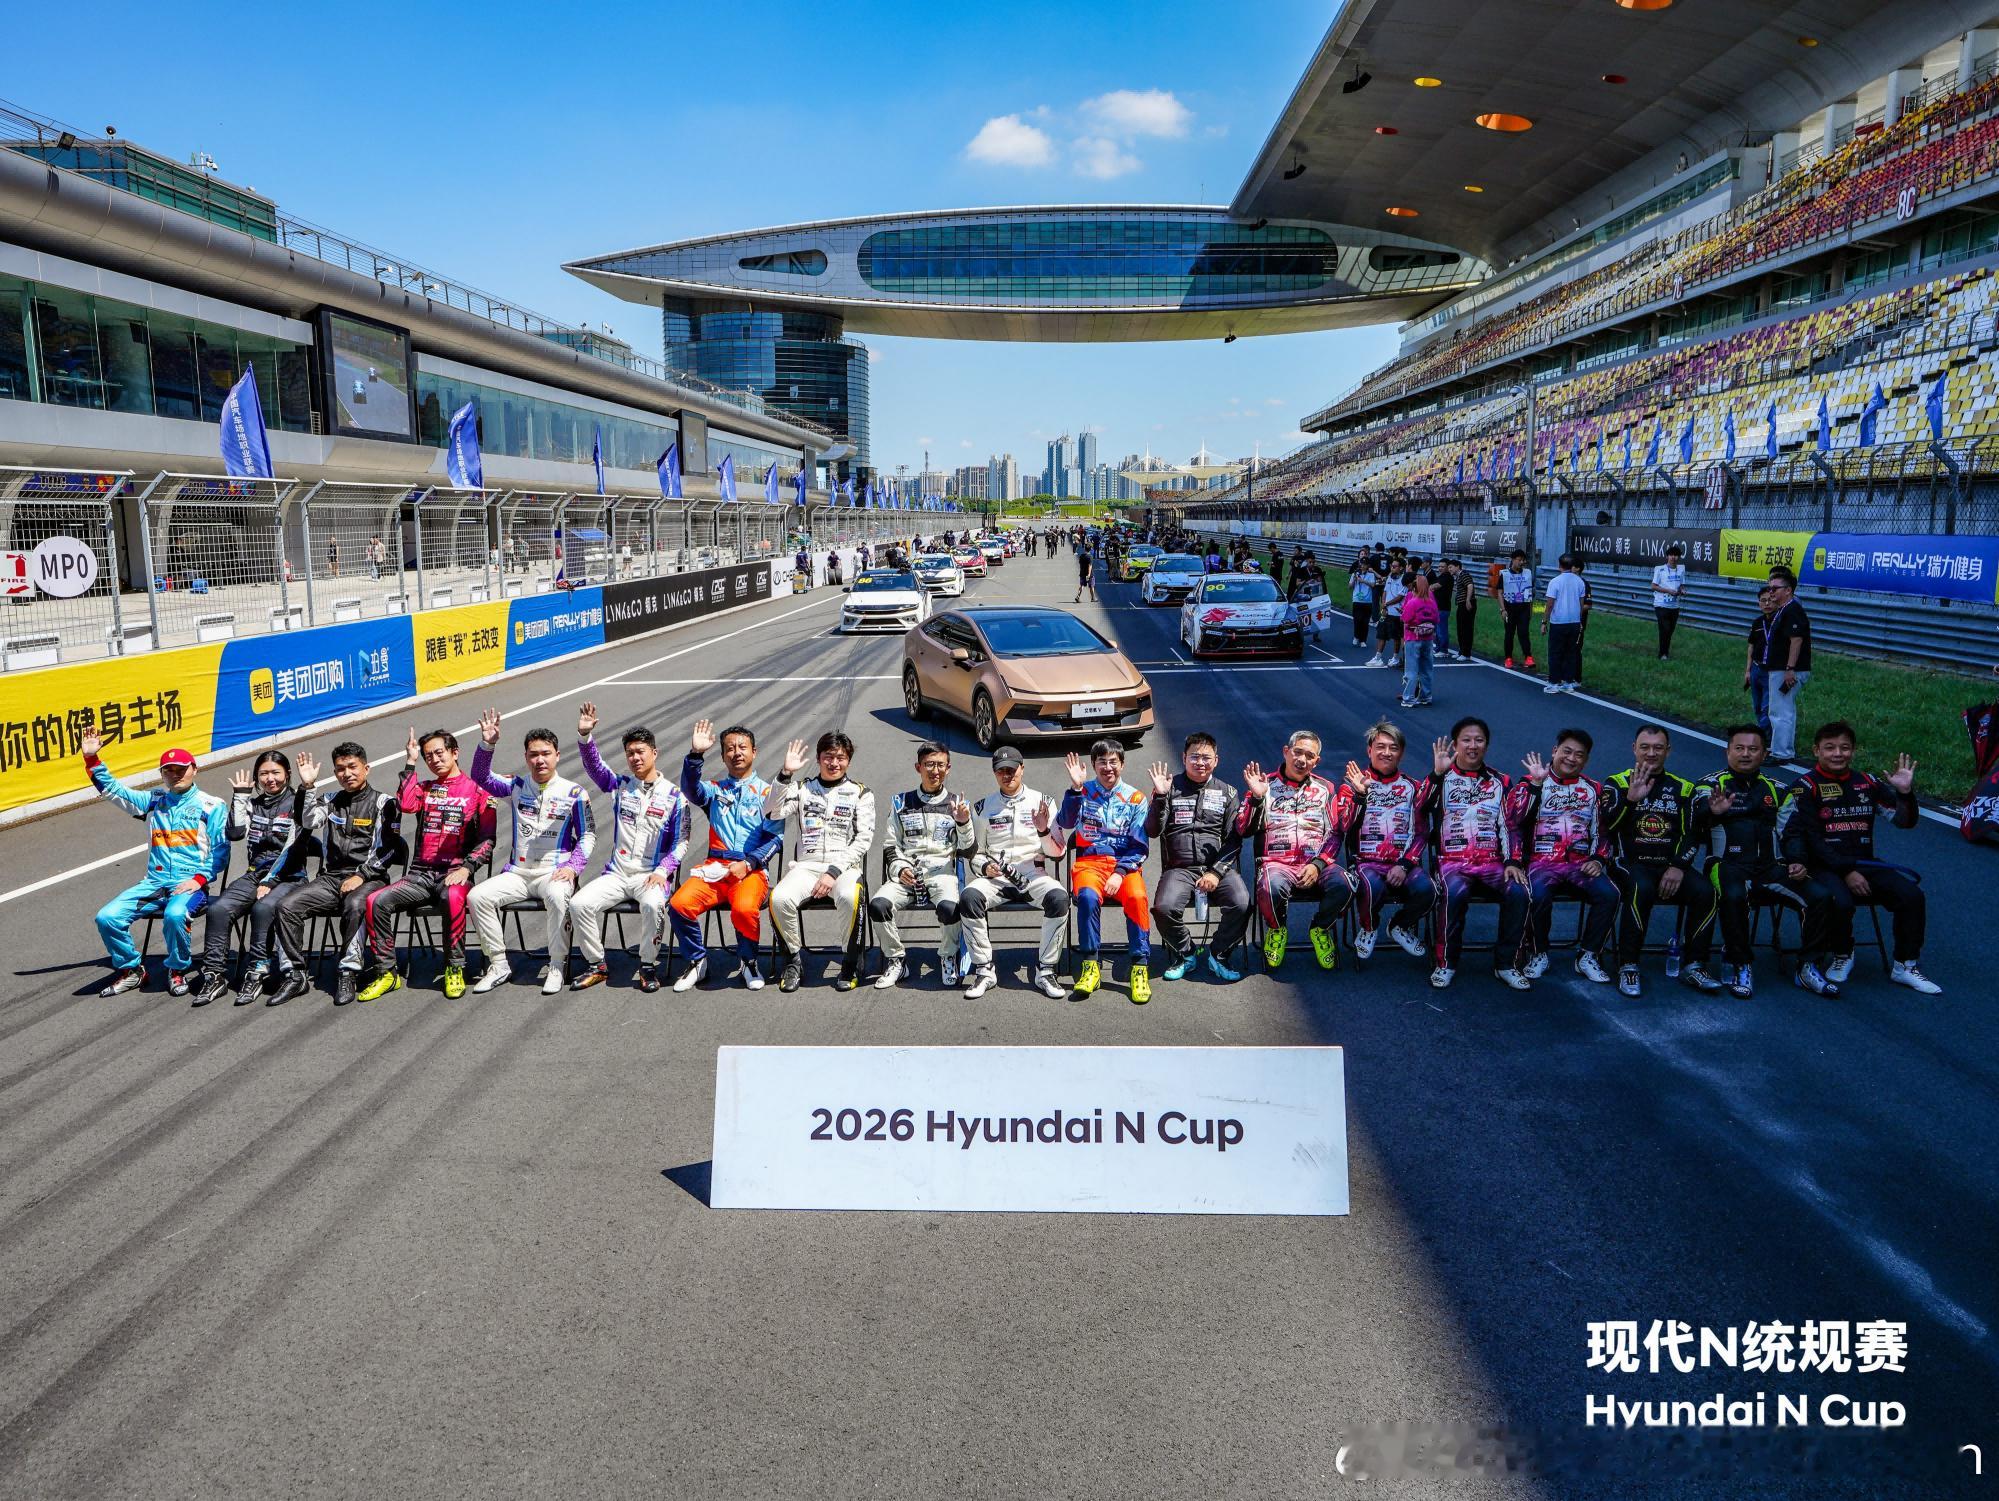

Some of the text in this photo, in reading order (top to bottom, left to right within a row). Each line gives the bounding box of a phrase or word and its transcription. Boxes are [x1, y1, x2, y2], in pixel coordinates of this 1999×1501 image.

[1898, 186, 1916, 220] 8C
[1394, 531, 1413, 543] CHERY
[1380, 559, 1387, 570] 5
[1827, 552, 1866, 571] 美团团购
[1872, 552, 1928, 570] REALLY
[1927, 554, 1983, 581] 瑞力健身
[1206, 583, 1226, 592] 90
[253, 681, 273, 700] 美团
[277, 659, 345, 704] 美团团购
[0, 689, 183, 773] 你的健身主场
[811, 1108, 1243, 1152] 2026 Hyundai N Cup
